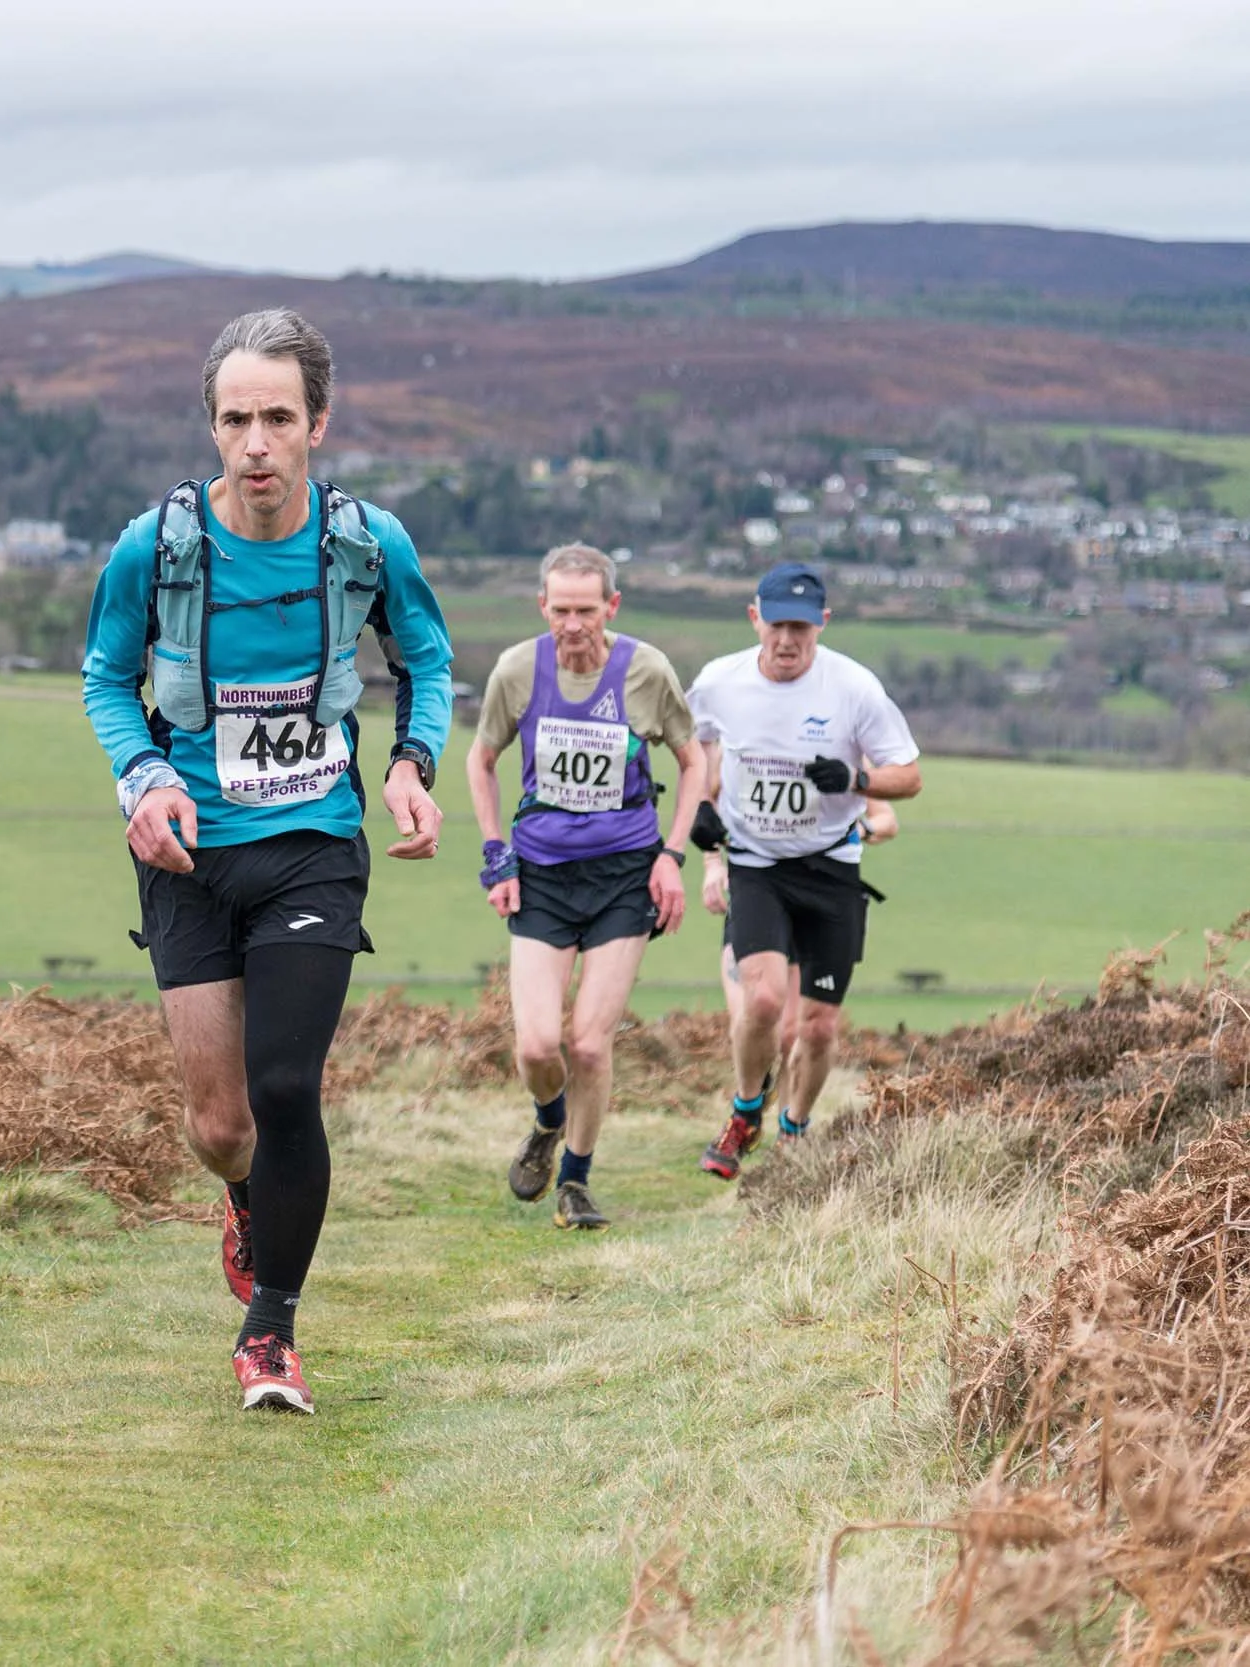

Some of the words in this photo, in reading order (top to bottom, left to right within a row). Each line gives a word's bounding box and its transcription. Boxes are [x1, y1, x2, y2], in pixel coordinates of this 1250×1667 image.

[230, 776, 281, 792] PETE
[286, 759, 347, 785] BLAND
[550, 751, 612, 786] 402
[260, 780, 318, 799] SPORTS
[542, 783, 573, 795] PETE
[577, 789, 621, 799] BLAND
[750, 780, 806, 814] 470
